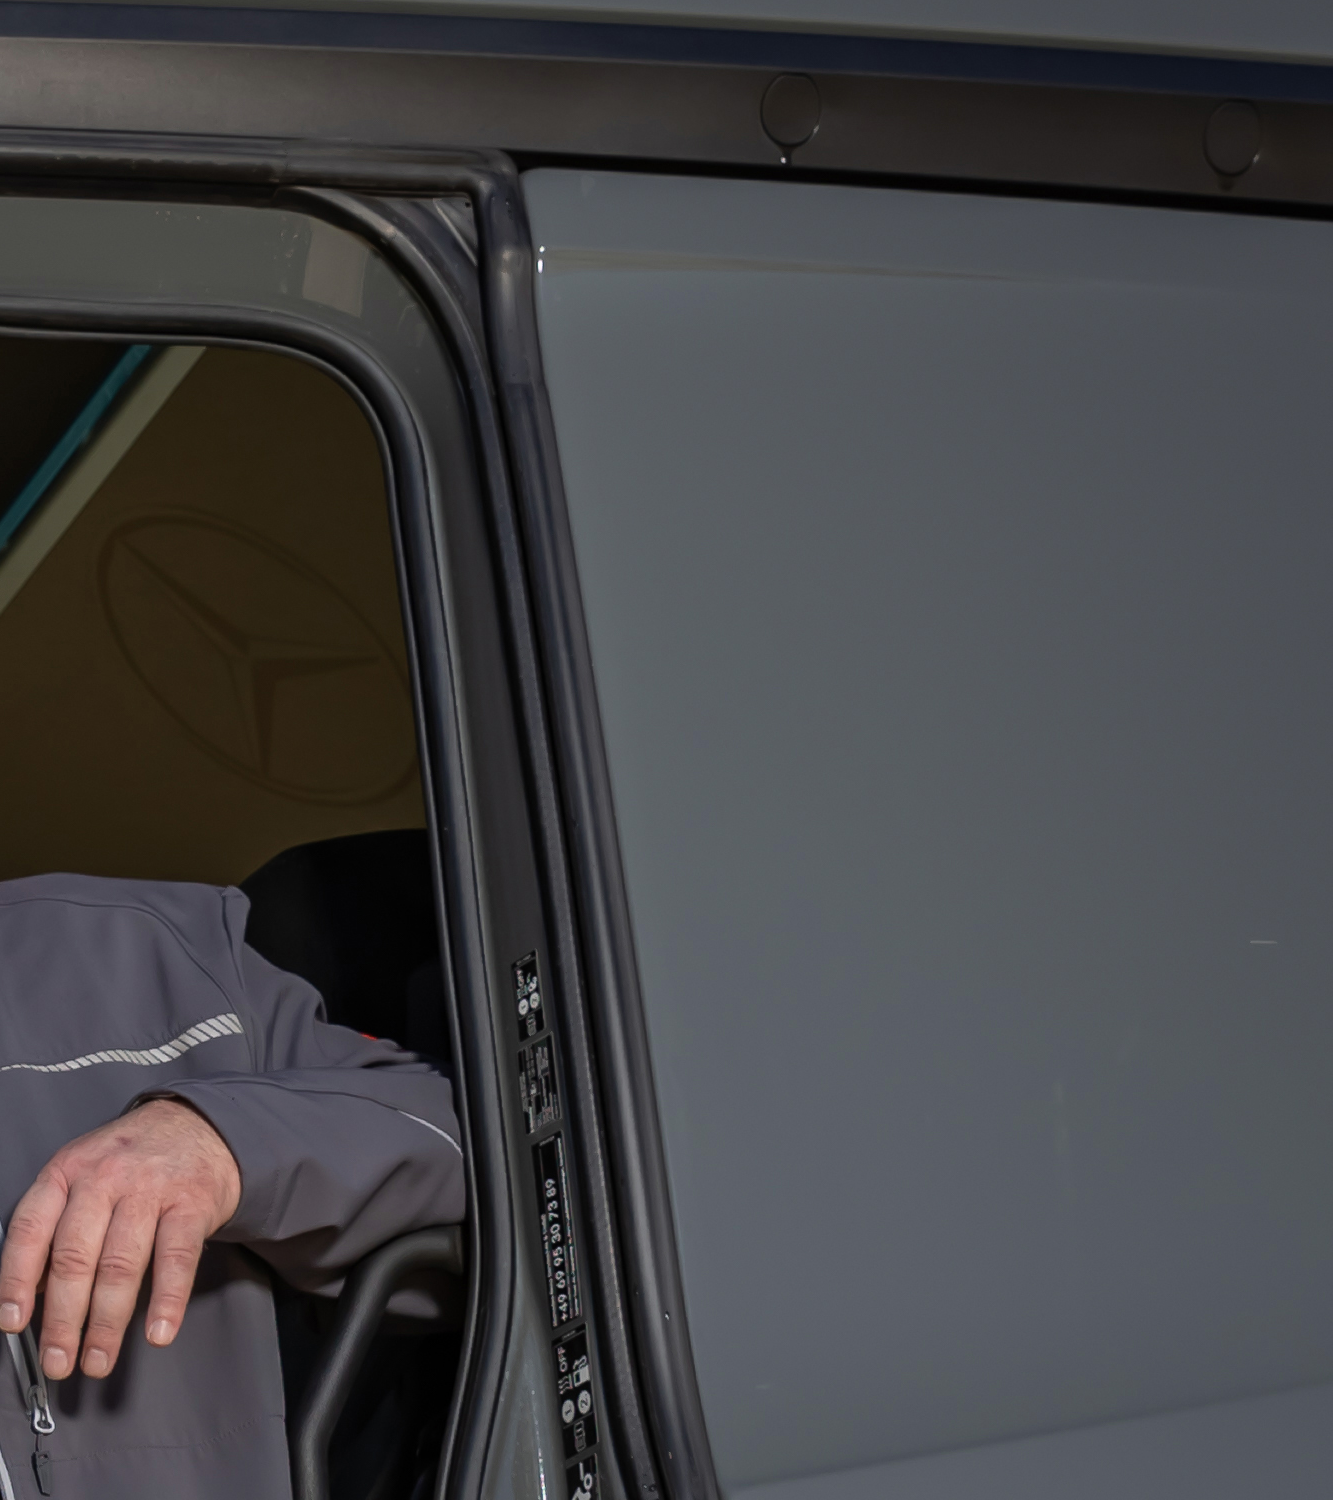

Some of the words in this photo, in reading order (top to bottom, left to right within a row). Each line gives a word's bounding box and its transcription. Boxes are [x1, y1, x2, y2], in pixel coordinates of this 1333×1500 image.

[547, 1200, 559, 1222] 73
[550, 1223, 562, 1244] 30
[552, 1246, 564, 1267] 95
[555, 1270, 566, 1289] 69
[558, 1293, 569, 1322] +49
